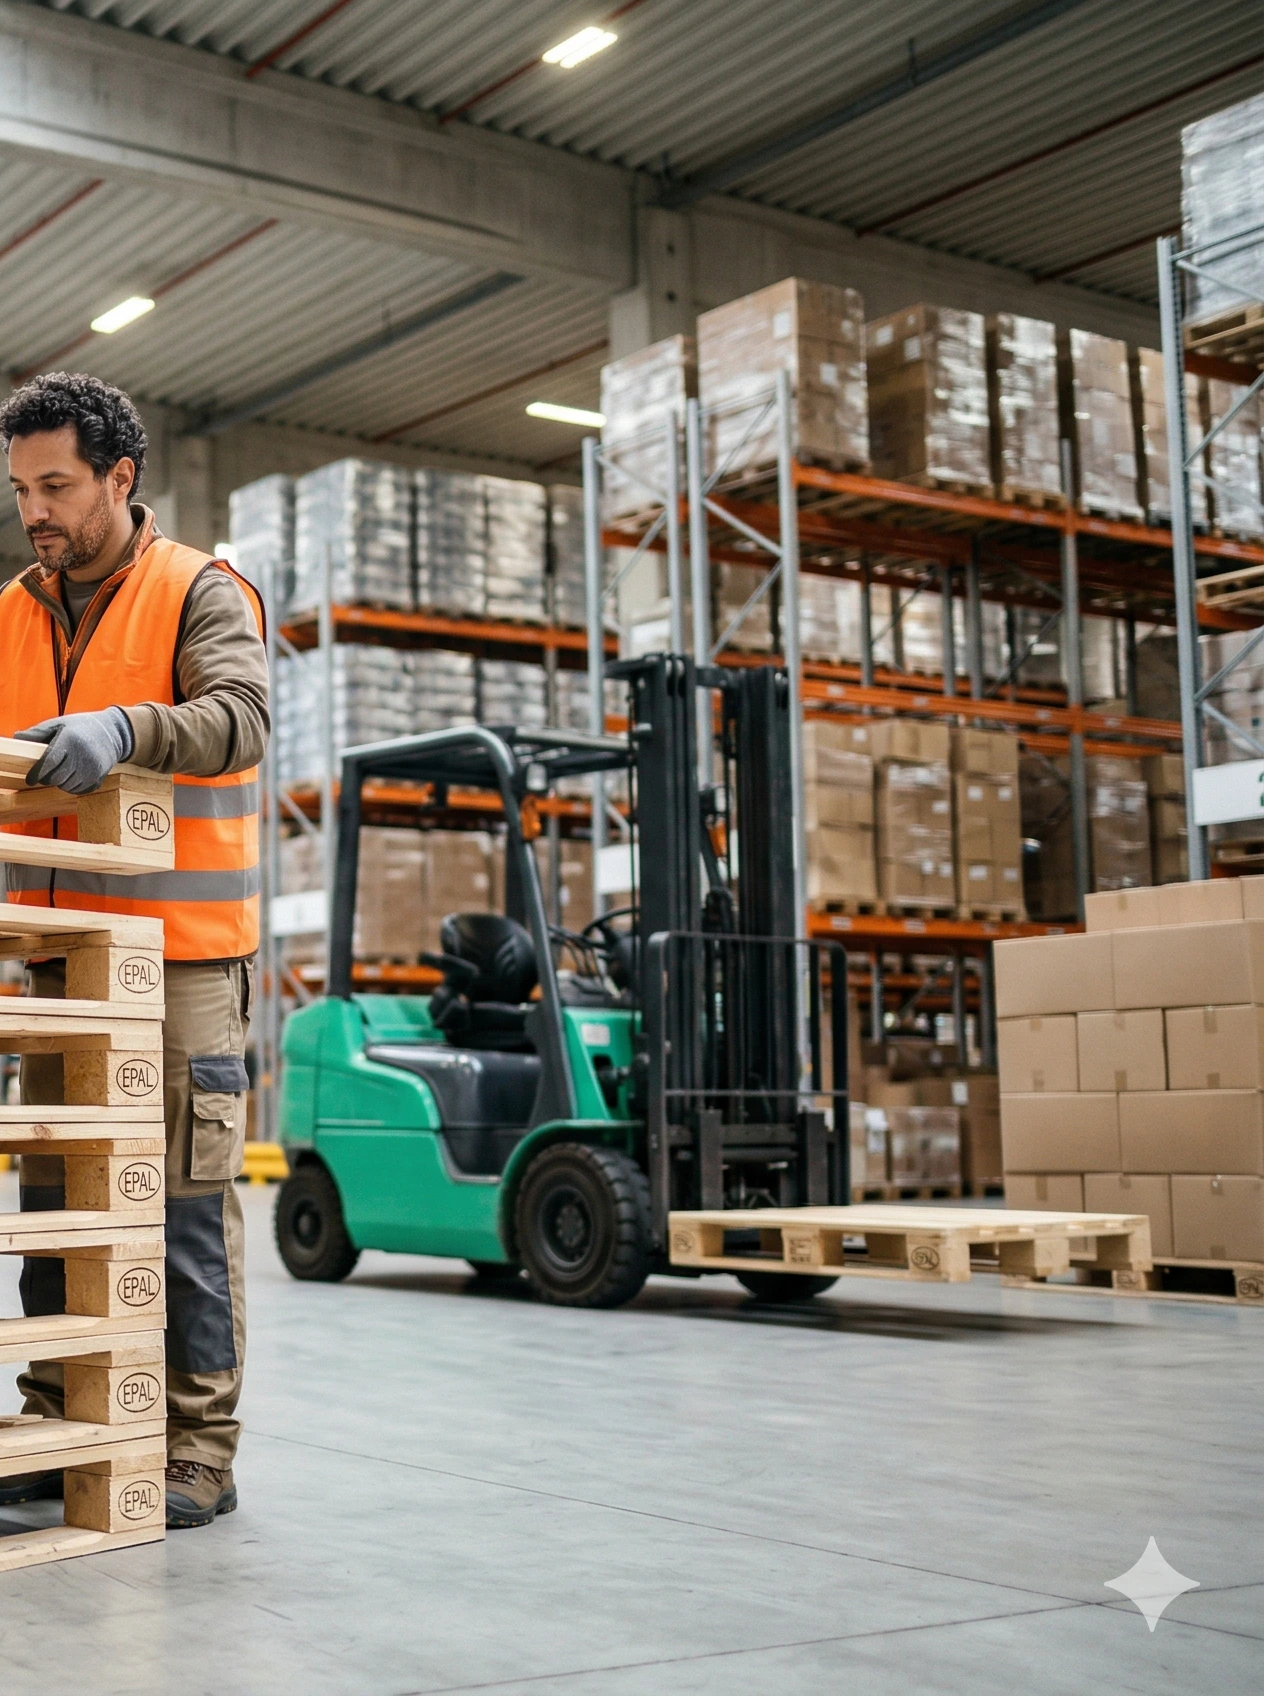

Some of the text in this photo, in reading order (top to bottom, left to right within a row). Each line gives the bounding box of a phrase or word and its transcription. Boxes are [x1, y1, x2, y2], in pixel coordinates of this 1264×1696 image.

[132, 809, 164, 833] EPAL
[125, 965, 155, 985] EPAL
[123, 1067, 153, 1087] EPAL
[125, 1171, 155, 1193] EPAL
[124, 1275, 156, 1299] EPAL
[124, 1381, 155, 1405] EPAL
[125, 1488, 158, 1513] EPAL
